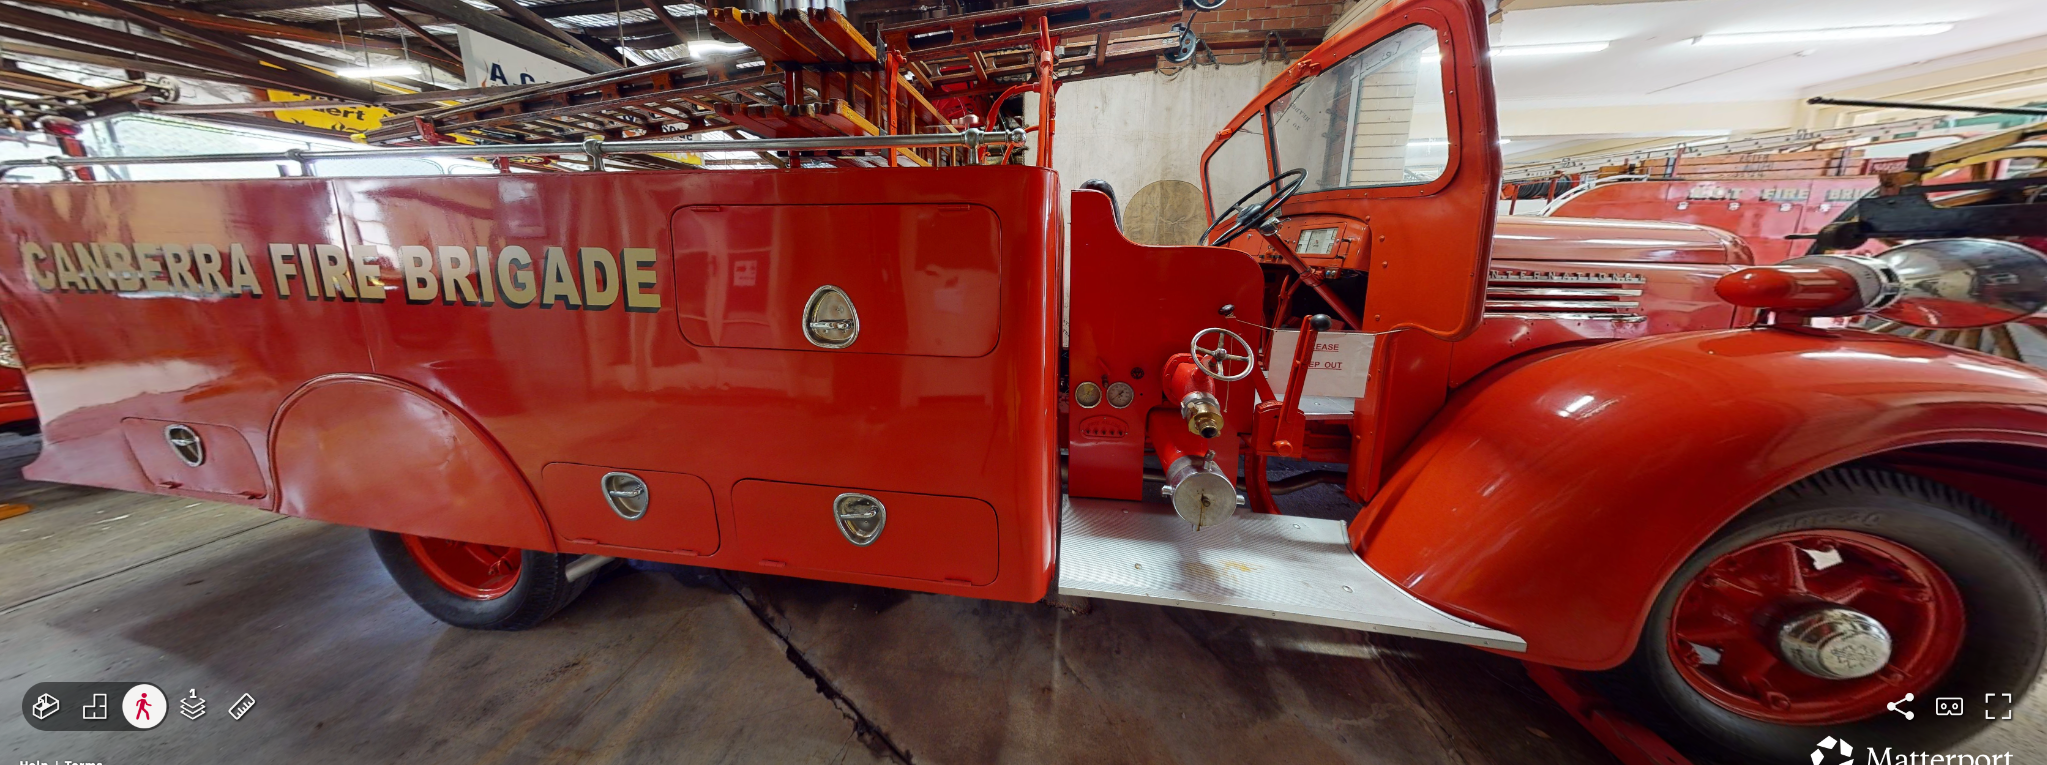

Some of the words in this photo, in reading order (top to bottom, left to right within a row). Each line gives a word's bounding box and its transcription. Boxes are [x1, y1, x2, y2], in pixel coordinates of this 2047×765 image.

[1759, 188, 1810, 202] FIRE
[22, 242, 263, 296] CANBERRA
[268, 242, 387, 304] FIRE
[399, 245, 662, 313] BRIGADE
[1489, 270, 1646, 283] NTERNATIONAL
